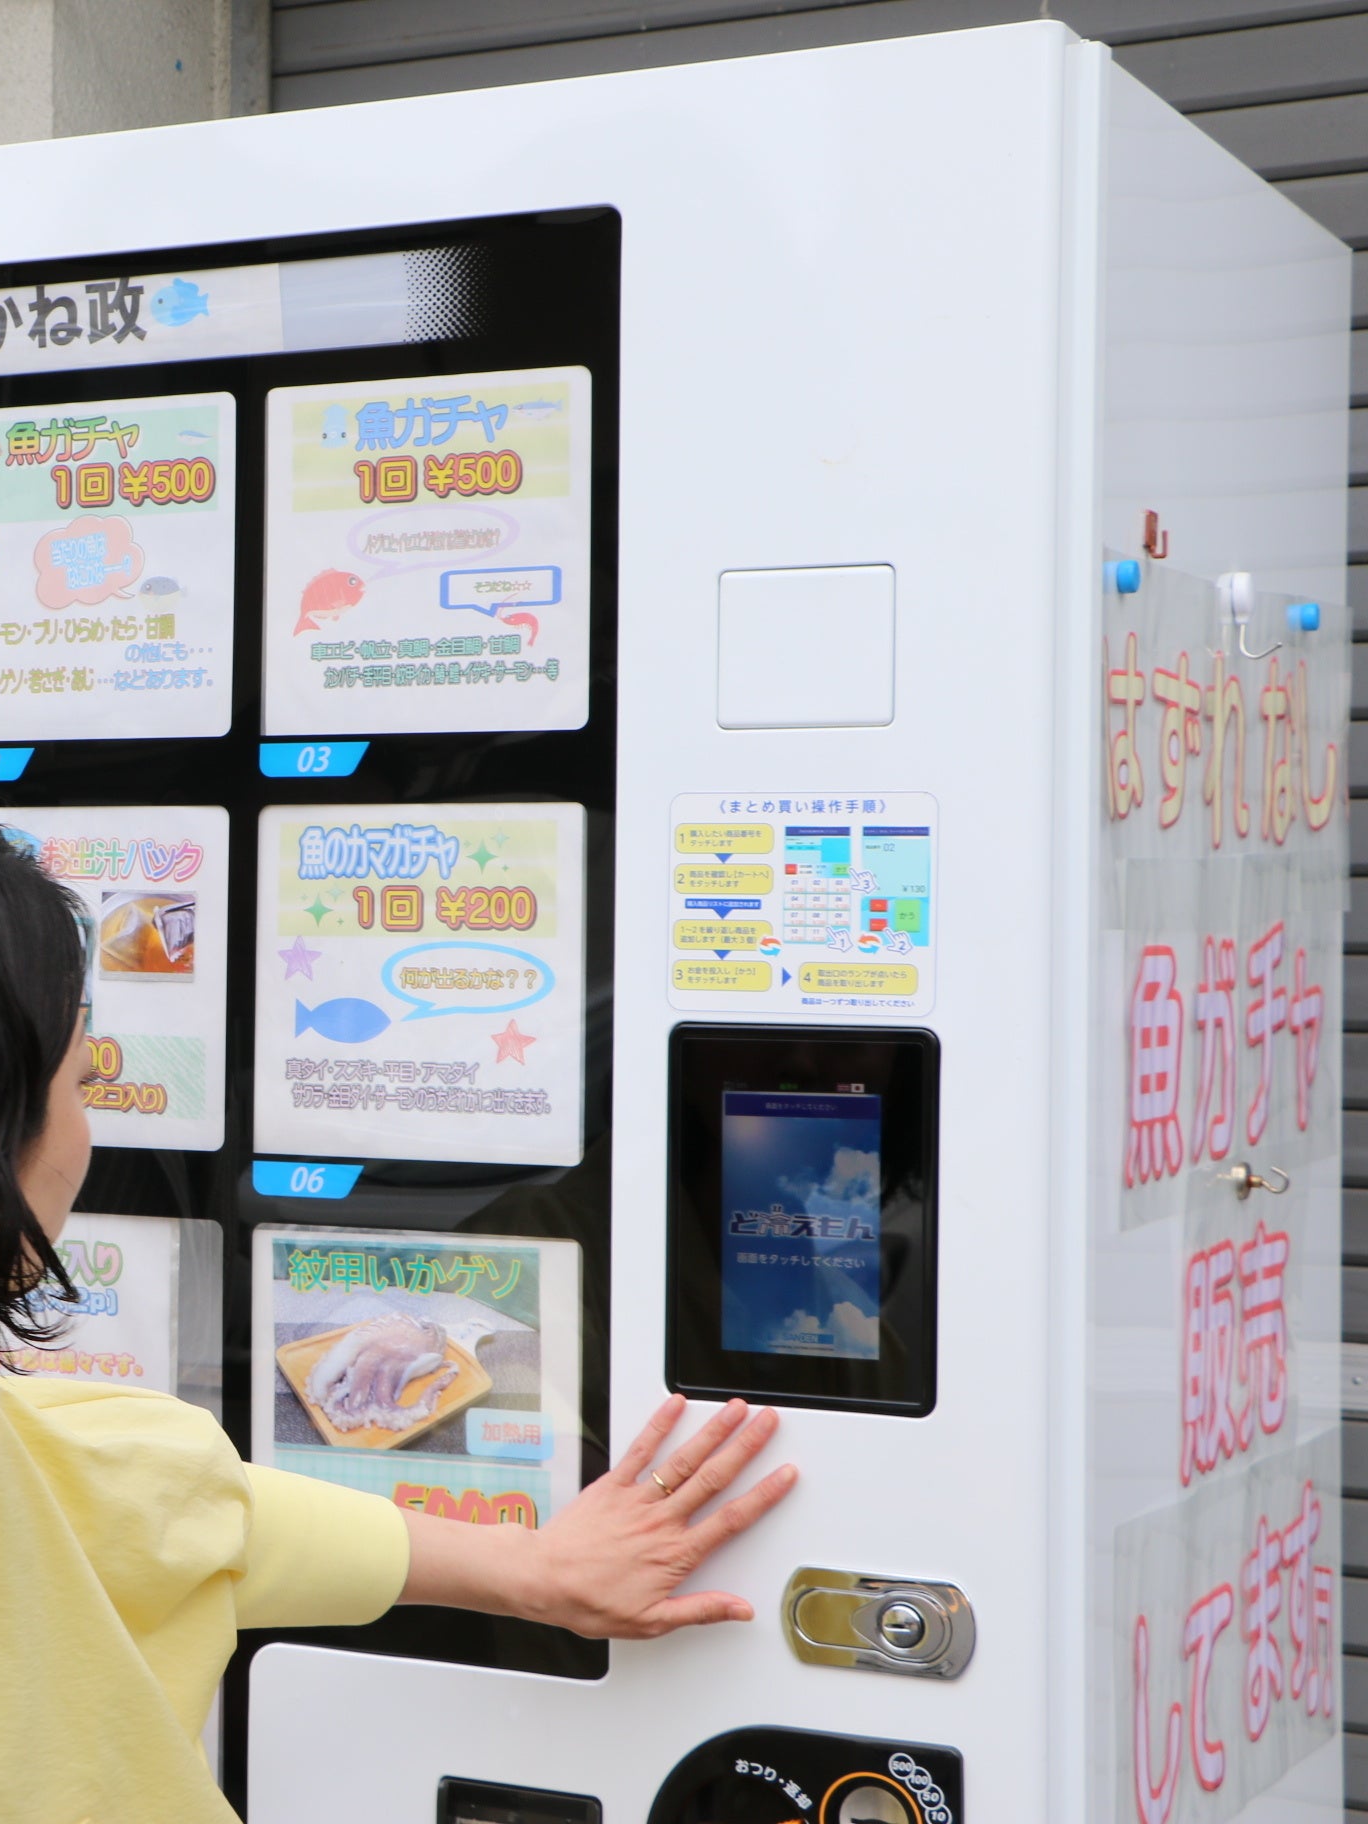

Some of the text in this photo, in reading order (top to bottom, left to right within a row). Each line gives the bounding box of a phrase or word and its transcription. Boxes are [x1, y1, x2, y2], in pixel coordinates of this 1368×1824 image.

[5, 416, 140, 467] 魚ガチャ
[355, 394, 509, 451] 魚ガチャ
[119, 457, 216, 507] ¥500
[424, 449, 523, 498] ¥500
[296, 745, 332, 774] 03
[1103, 630, 1338, 850] はずれなし
[40, 836, 206, 883] お出汁パック
[297, 823, 460, 880] 魚のカマガチャ
[435, 886, 538, 931] ¥200
[675, 969, 684, 981] 3
[802, 970, 812, 983] 4
[289, 1166, 326, 1194] 06
[729, 1203, 876, 1241] ど冷えもん
[287, 1249, 523, 1300] 紋甲いかゲソ
[736, 1251, 867, 1270] 画面をタッチしてください
[1181, 1219, 1290, 1487] 販売
[481, 1420, 543, 1446] 加熱用
